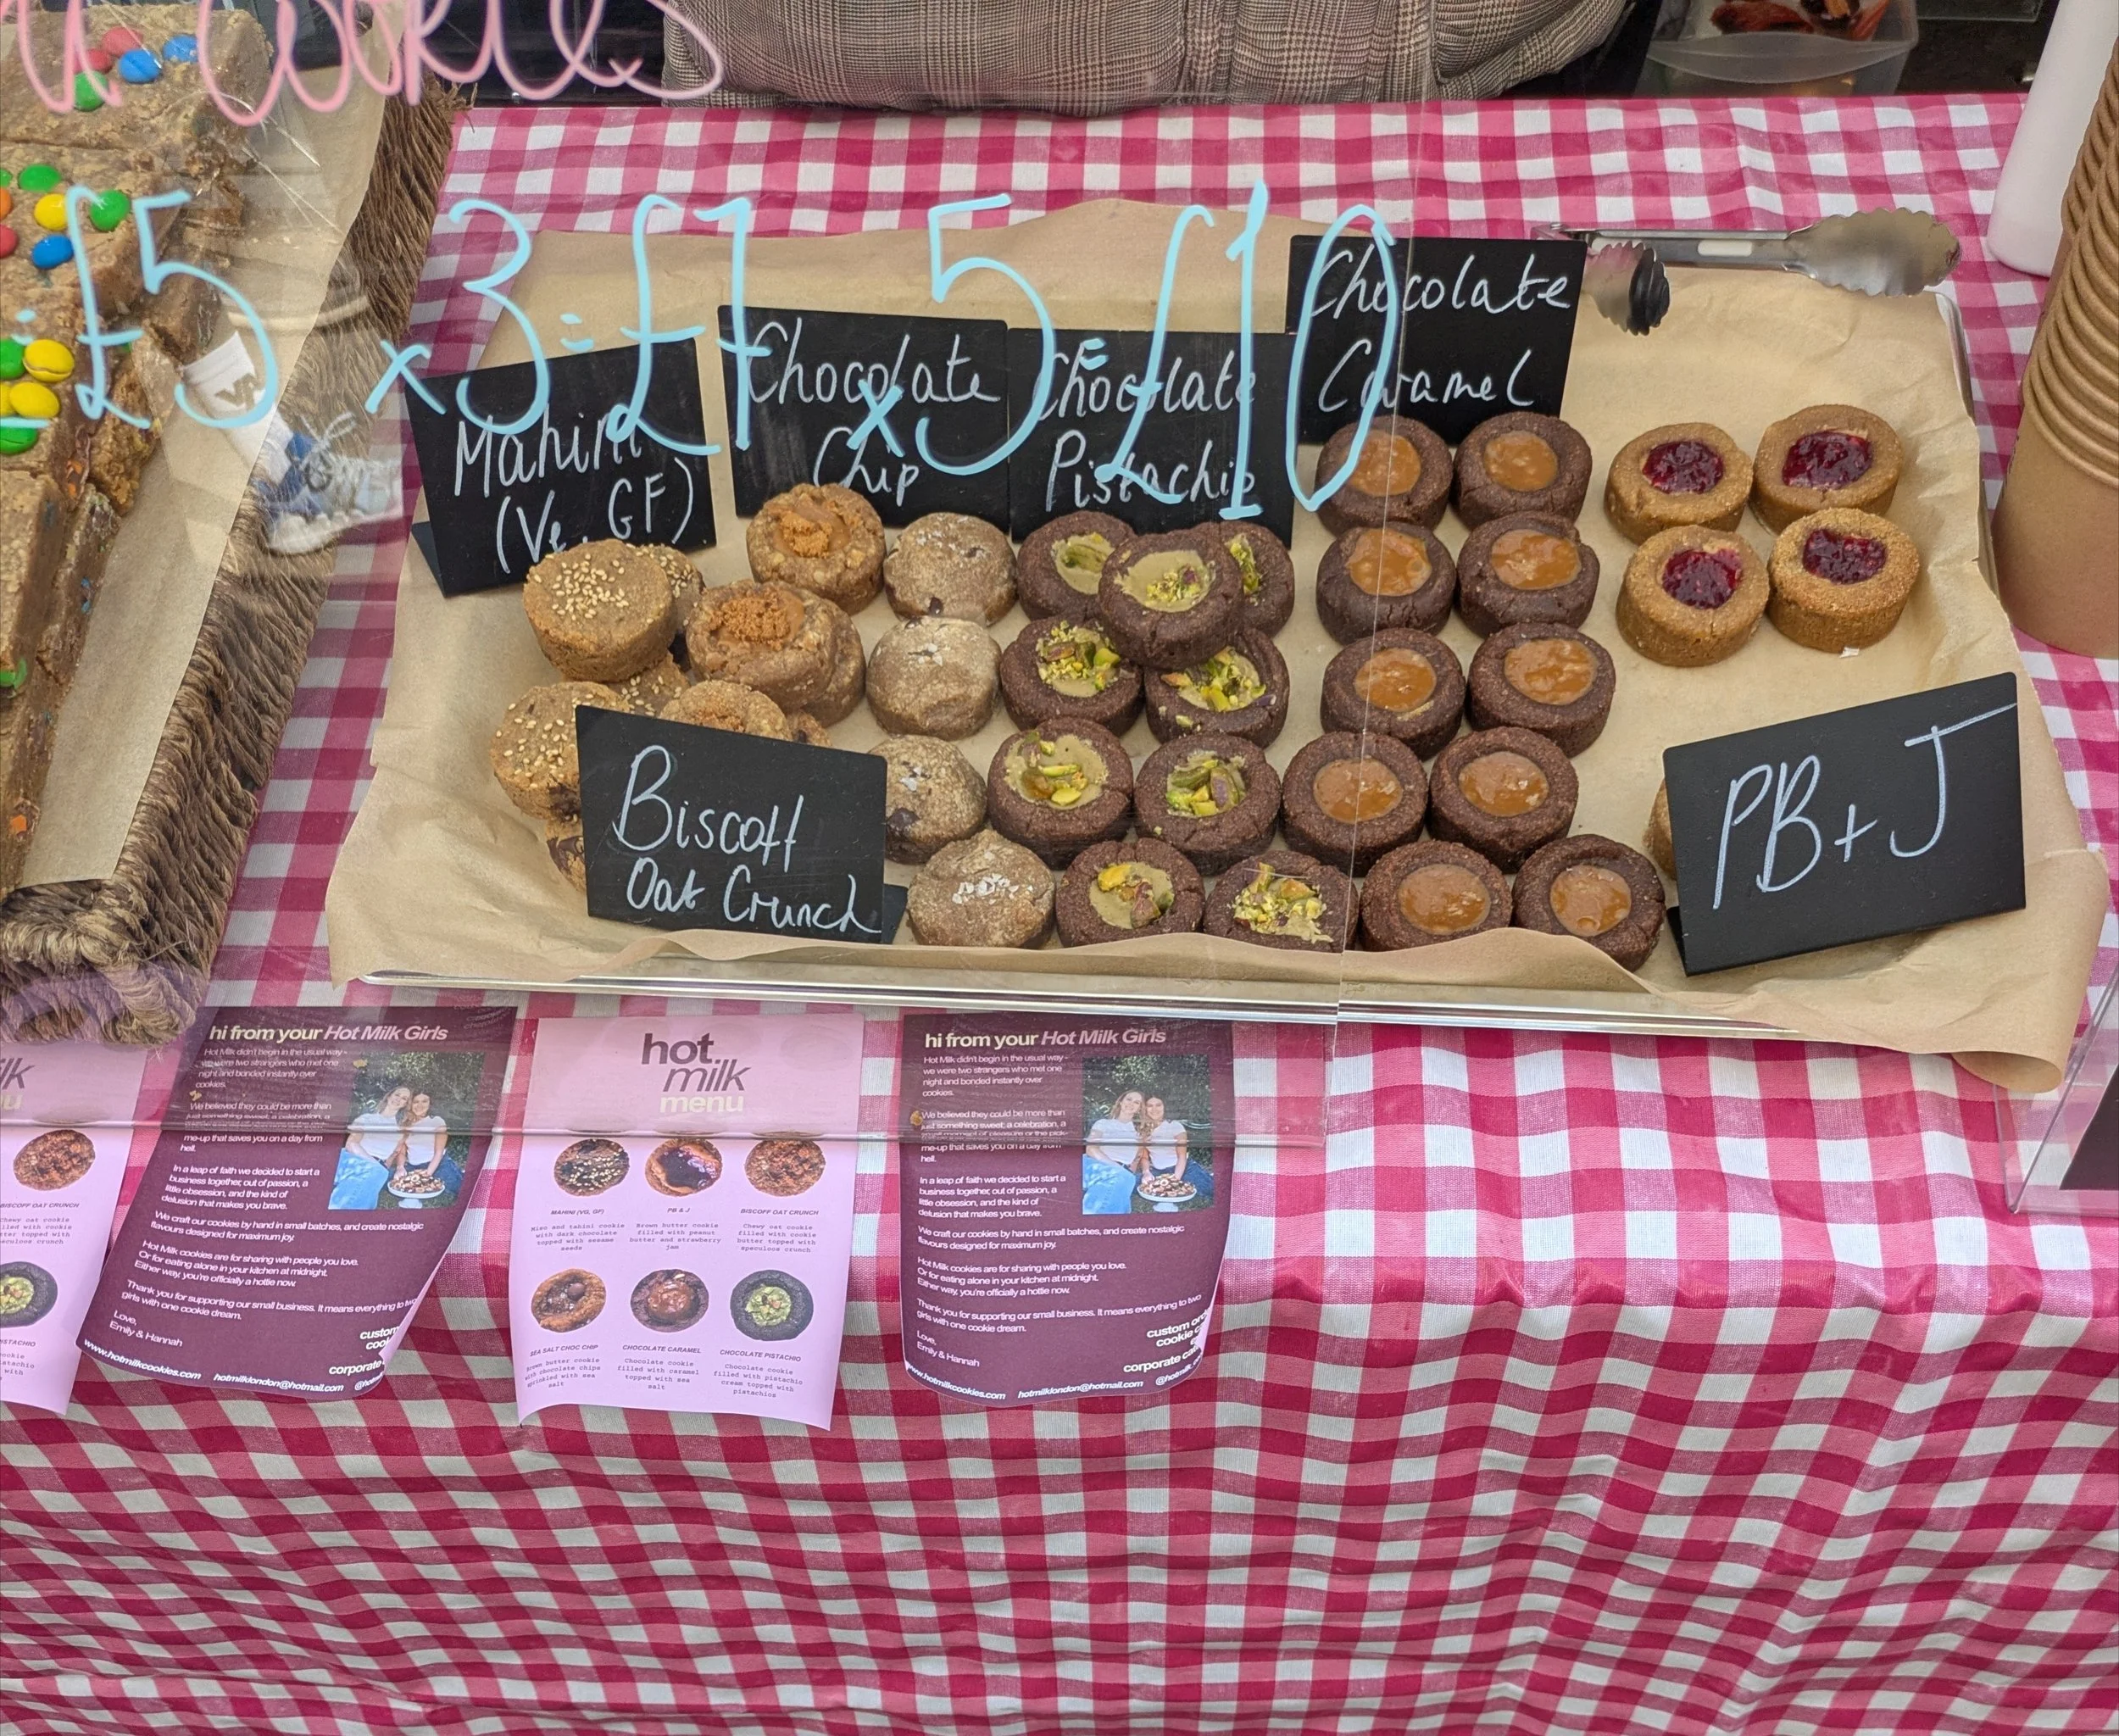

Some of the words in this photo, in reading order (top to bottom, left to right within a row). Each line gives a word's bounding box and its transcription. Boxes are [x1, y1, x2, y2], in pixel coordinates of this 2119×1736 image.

[1310, 244, 1571, 319] Chocolate
[748, 316, 1001, 404] Chocolate
[813, 426, 920, 506] Chip
[608, 457, 693, 544] GF)
[626, 856, 705, 912] Oat
[723, 865, 882, 932] Crunch
[209, 1026, 226, 1040] hi
[231, 1026, 275, 1041] from
[276, 1027, 322, 1044] your
[323, 1026, 357, 1040] Hot
[360, 1026, 400, 1040] Milk
[404, 1026, 448, 1040] Girls
[925, 1033, 942, 1048] hi
[946, 1033, 991, 1048] from
[994, 1034, 1038, 1050] your
[1041, 1031, 1076, 1045] Hot
[1078, 1030, 1119, 1045] Milk
[1121, 1028, 1166, 1044] Girls
[663, 1059, 752, 1092] milk
[659, 1095, 744, 1112] menu
[918, 1226, 932, 1235] We
[1000, 1230, 1010, 1238] by
[1043, 1228, 1065, 1237] small
[1148, 1225, 1185, 1234] nostalgic
[142, 1240, 159, 1251] Hot
[160, 1244, 178, 1255] Milk
[180, 1250, 213, 1260] cookies
[242, 1255, 274, 1265] sharing
[292, 1257, 322, 1266] people
[323, 1258, 339, 1266] you
[949, 1241, 987, 1251] designed
[1001, 1240, 1043, 1249] maximum
[114, 1310, 137, 1326] Love,
[109, 1321, 136, 1337] Emily
[145, 1332, 183, 1347] Hannah
[1146, 1321, 1190, 1338] custom
[1155, 1331, 1193, 1347] cookie
[84, 1338, 202, 1380] www.hotmilkcookies.com
[765, 1353, 801, 1361] PISTACHIO
[1123, 1354, 1181, 1373] corporate
[329, 1360, 381, 1377] corporate
[765, 1375, 803, 1385] pistachio
[733, 1389, 776, 1398] pistachios
